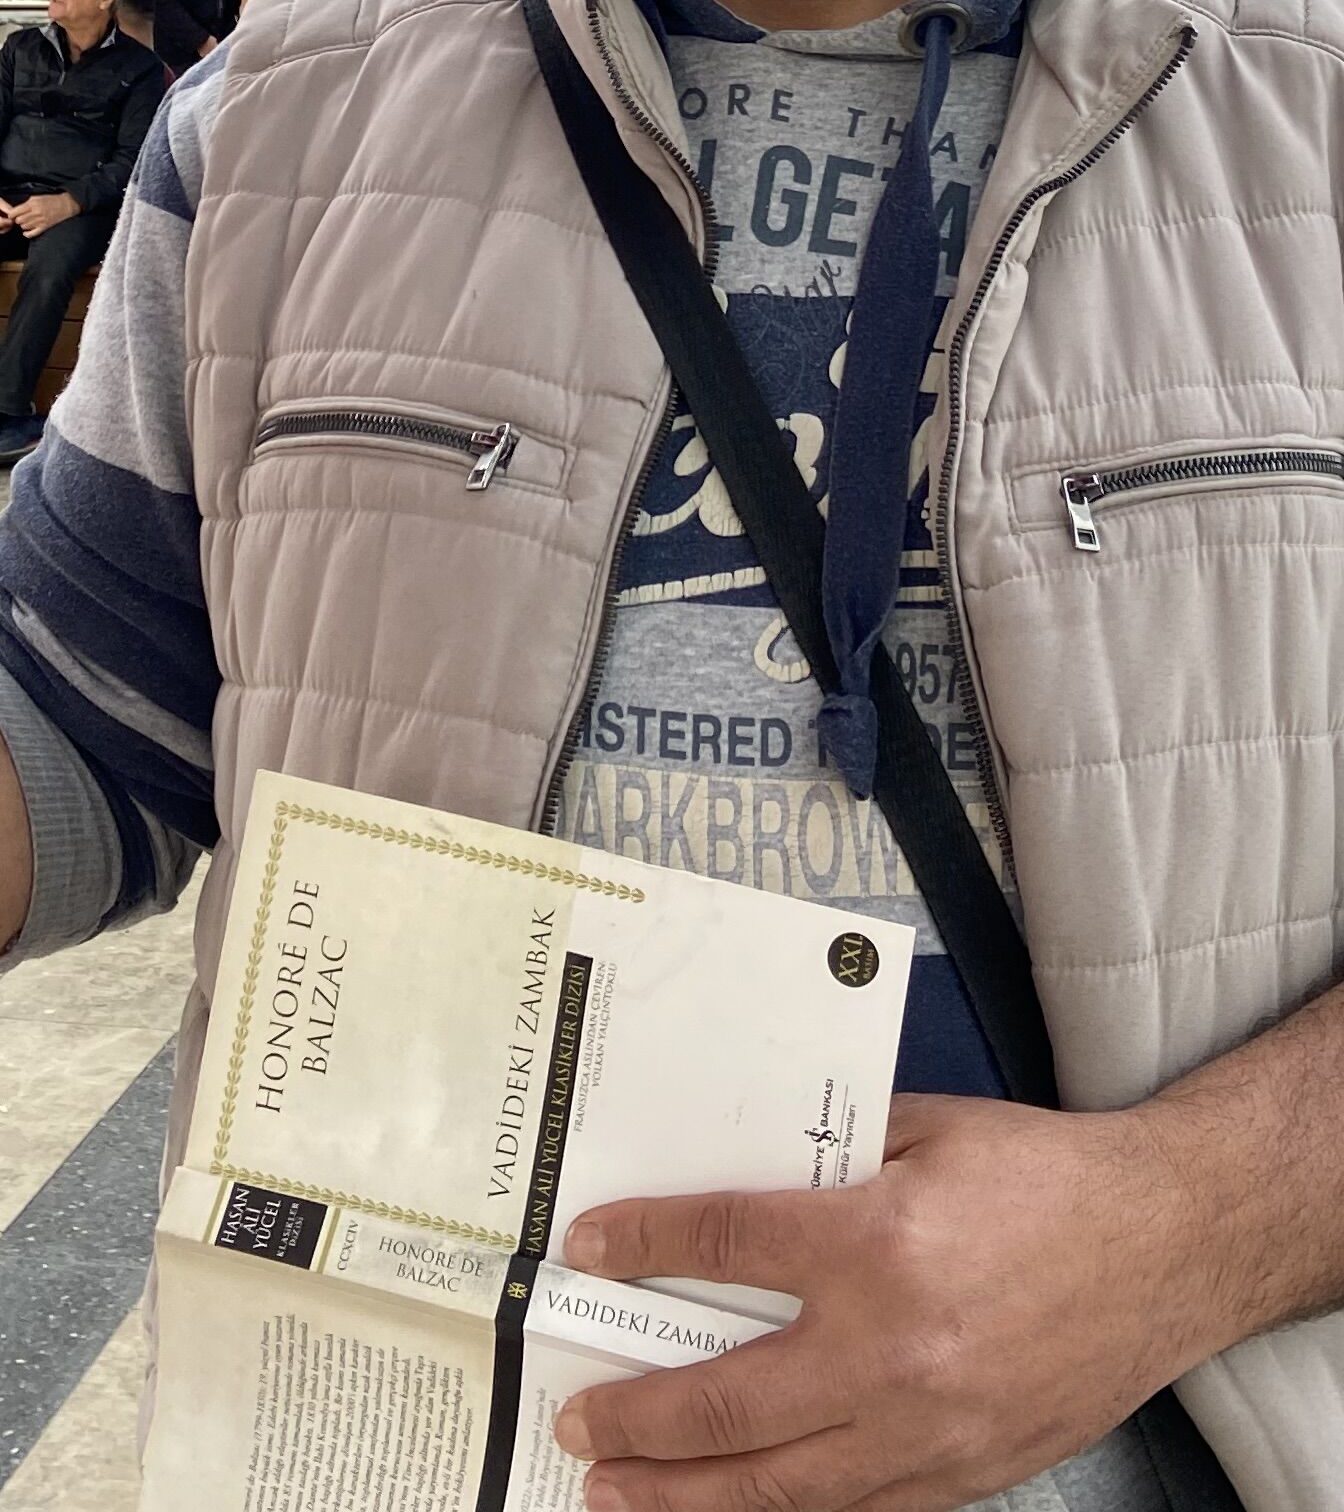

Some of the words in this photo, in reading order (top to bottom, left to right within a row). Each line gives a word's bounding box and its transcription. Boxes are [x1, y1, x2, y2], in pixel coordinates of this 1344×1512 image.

[255, 942, 308, 1113] HONORÉ
[287, 880, 320, 929] DE
[301, 935, 348, 1075] BALZAC
[563, 962, 587, 1017] DİZİSİ
[487, 1044, 536, 1200] VADİDEKİ
[514, 906, 556, 1036] ZAMBAK
[551, 1018, 579, 1108] KLASİKLER
[819, 1078, 834, 1128] BANKASI
[538, 1110, 566, 1165] YÜCEL
[220, 1187, 251, 1245] HASAN
[252, 1199, 282, 1250] YÜCEL
[337, 1219, 359, 1272] CCXCIV
[460, 1256, 485, 1278] DE
[396, 1262, 462, 1293] BALZAC
[547, 1290, 650, 1336] VADİDEKİ
